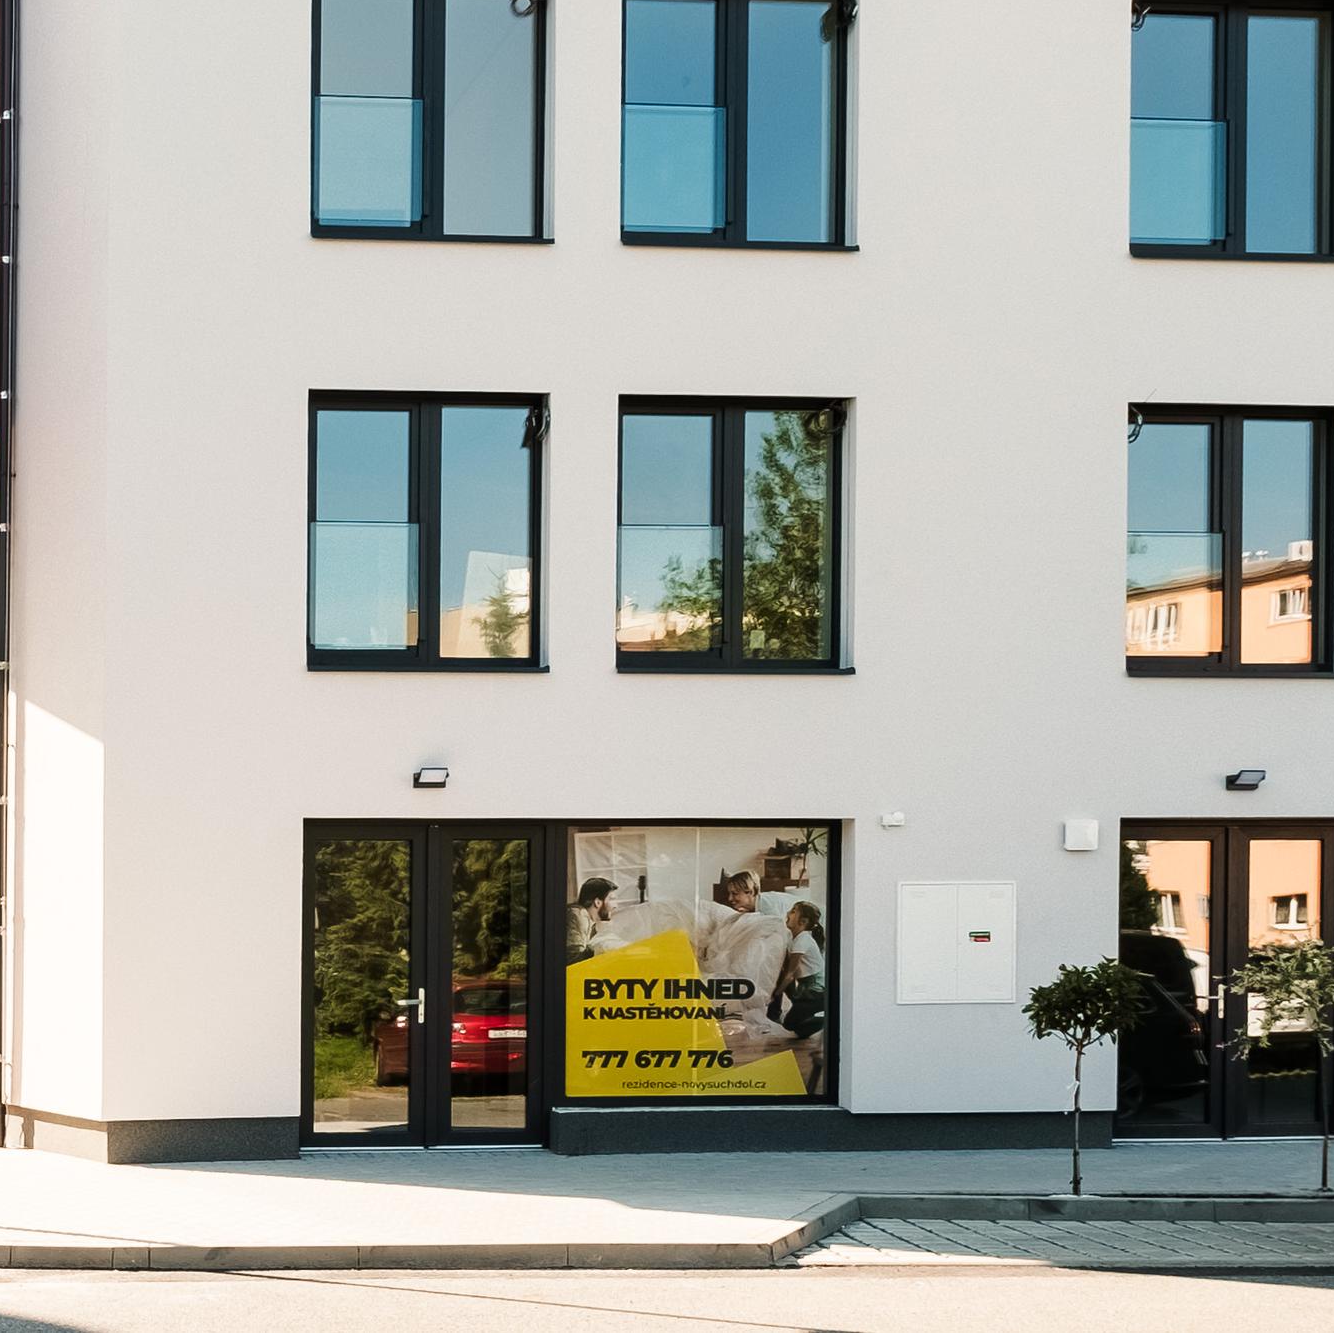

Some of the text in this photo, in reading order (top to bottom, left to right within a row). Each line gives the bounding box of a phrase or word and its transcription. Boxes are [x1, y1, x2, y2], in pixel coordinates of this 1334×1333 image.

[583, 978, 756, 1000] BYTY IHNED
[583, 1003, 727, 1020] K NASTĚHOVANÍ
[582, 1050, 734, 1068] 777 677 776
[622, 1079, 767, 1091] rezidence-novysuchdol.cz
